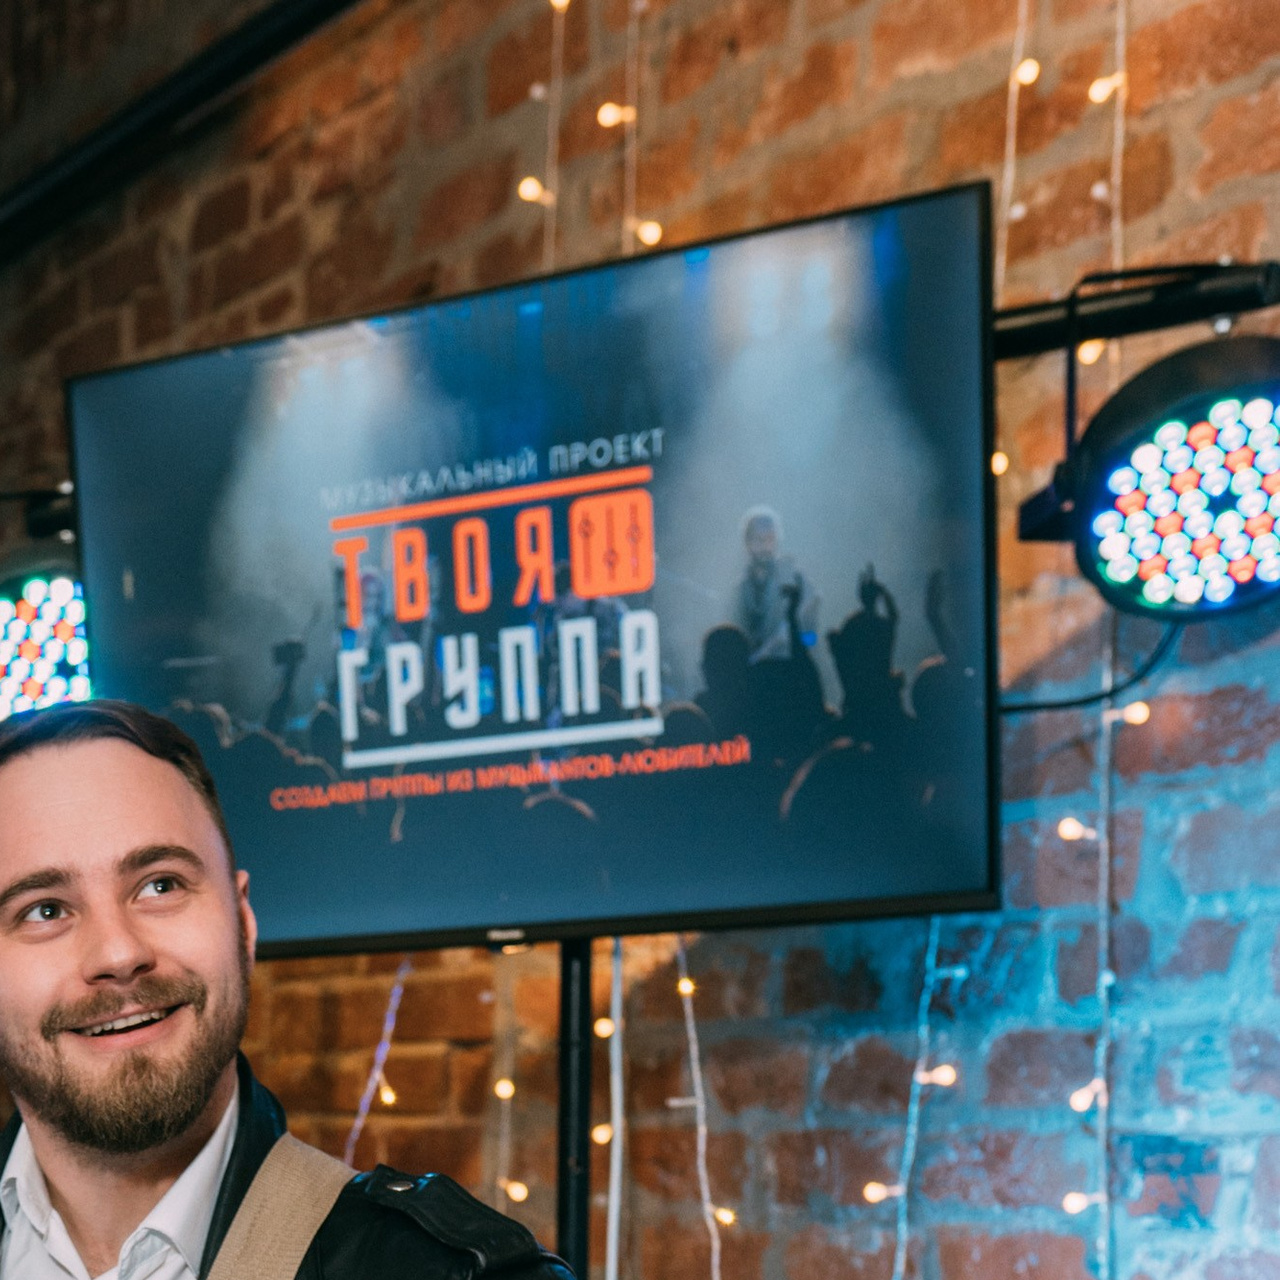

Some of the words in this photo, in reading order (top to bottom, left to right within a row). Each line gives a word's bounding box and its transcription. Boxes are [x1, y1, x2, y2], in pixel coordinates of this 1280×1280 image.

[321, 446, 538, 509] МУЗЫКАЛЬНЫЙ
[549, 428, 665, 474] ПРОЕКТ
[333, 506, 556, 629] ТВОЯ
[338, 610, 662, 742] ГРУППА
[446, 768, 474, 792] ИЗ
